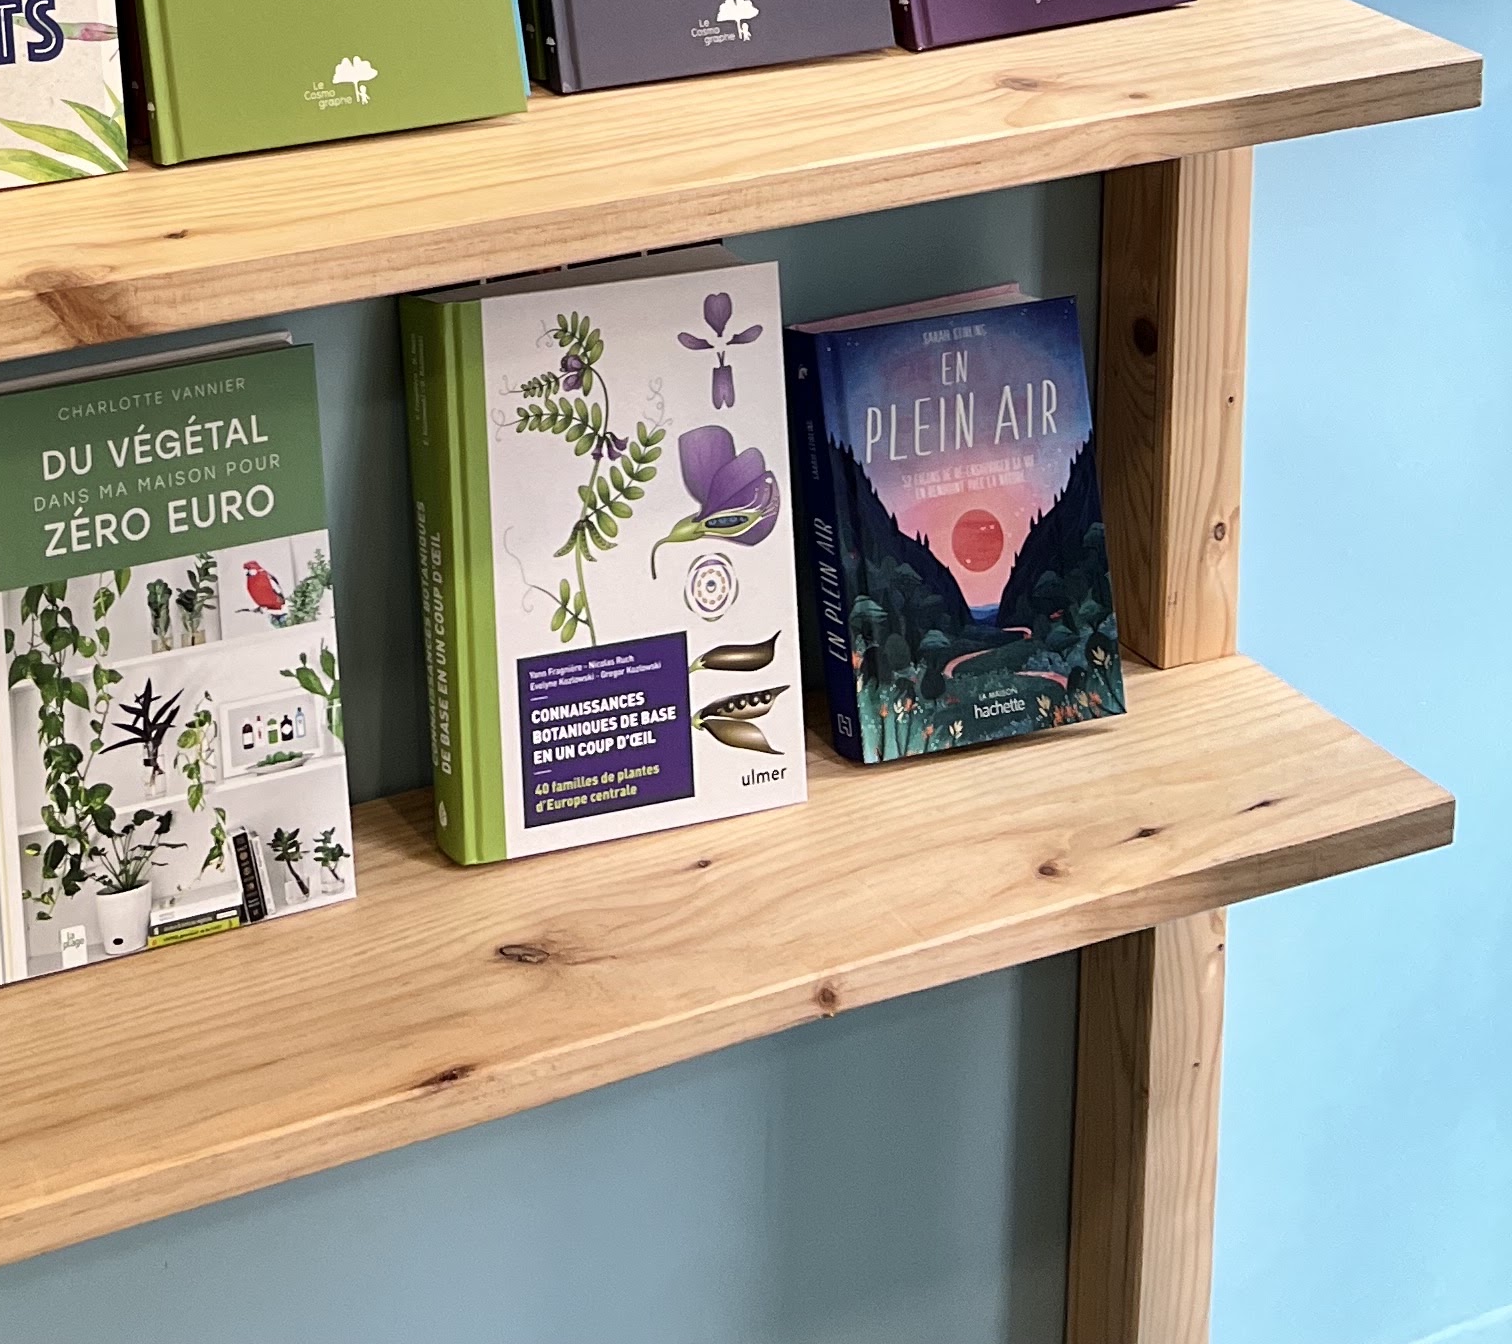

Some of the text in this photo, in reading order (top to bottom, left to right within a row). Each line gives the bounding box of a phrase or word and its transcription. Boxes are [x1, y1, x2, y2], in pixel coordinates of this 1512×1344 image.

[941, 350, 968, 386] EN
[57, 377, 246, 421] CHARLOTTE VANNIER
[866, 392, 975, 464] PLEIN
[994, 379, 1057, 445] AIR
[42, 414, 268, 481] DU VÉGÉTAL
[34, 453, 281, 513] DANS MA MAISON POUR
[44, 484, 275, 557] ZÉRO EURO
[813, 517, 848, 663] EN PLEIN AIR
[531, 691, 645, 724] CONNAISSANCES
[532, 706, 677, 745] BOTANIQUES DE BASE
[974, 697, 1026, 719] hachette
[533, 730, 656, 765] EN UN COUP D'ŒIL
[534, 763, 660, 795] 40 familles de plantes
[741, 764, 788, 789] ulmer
[535, 784, 637, 813] d'Europe centrale
